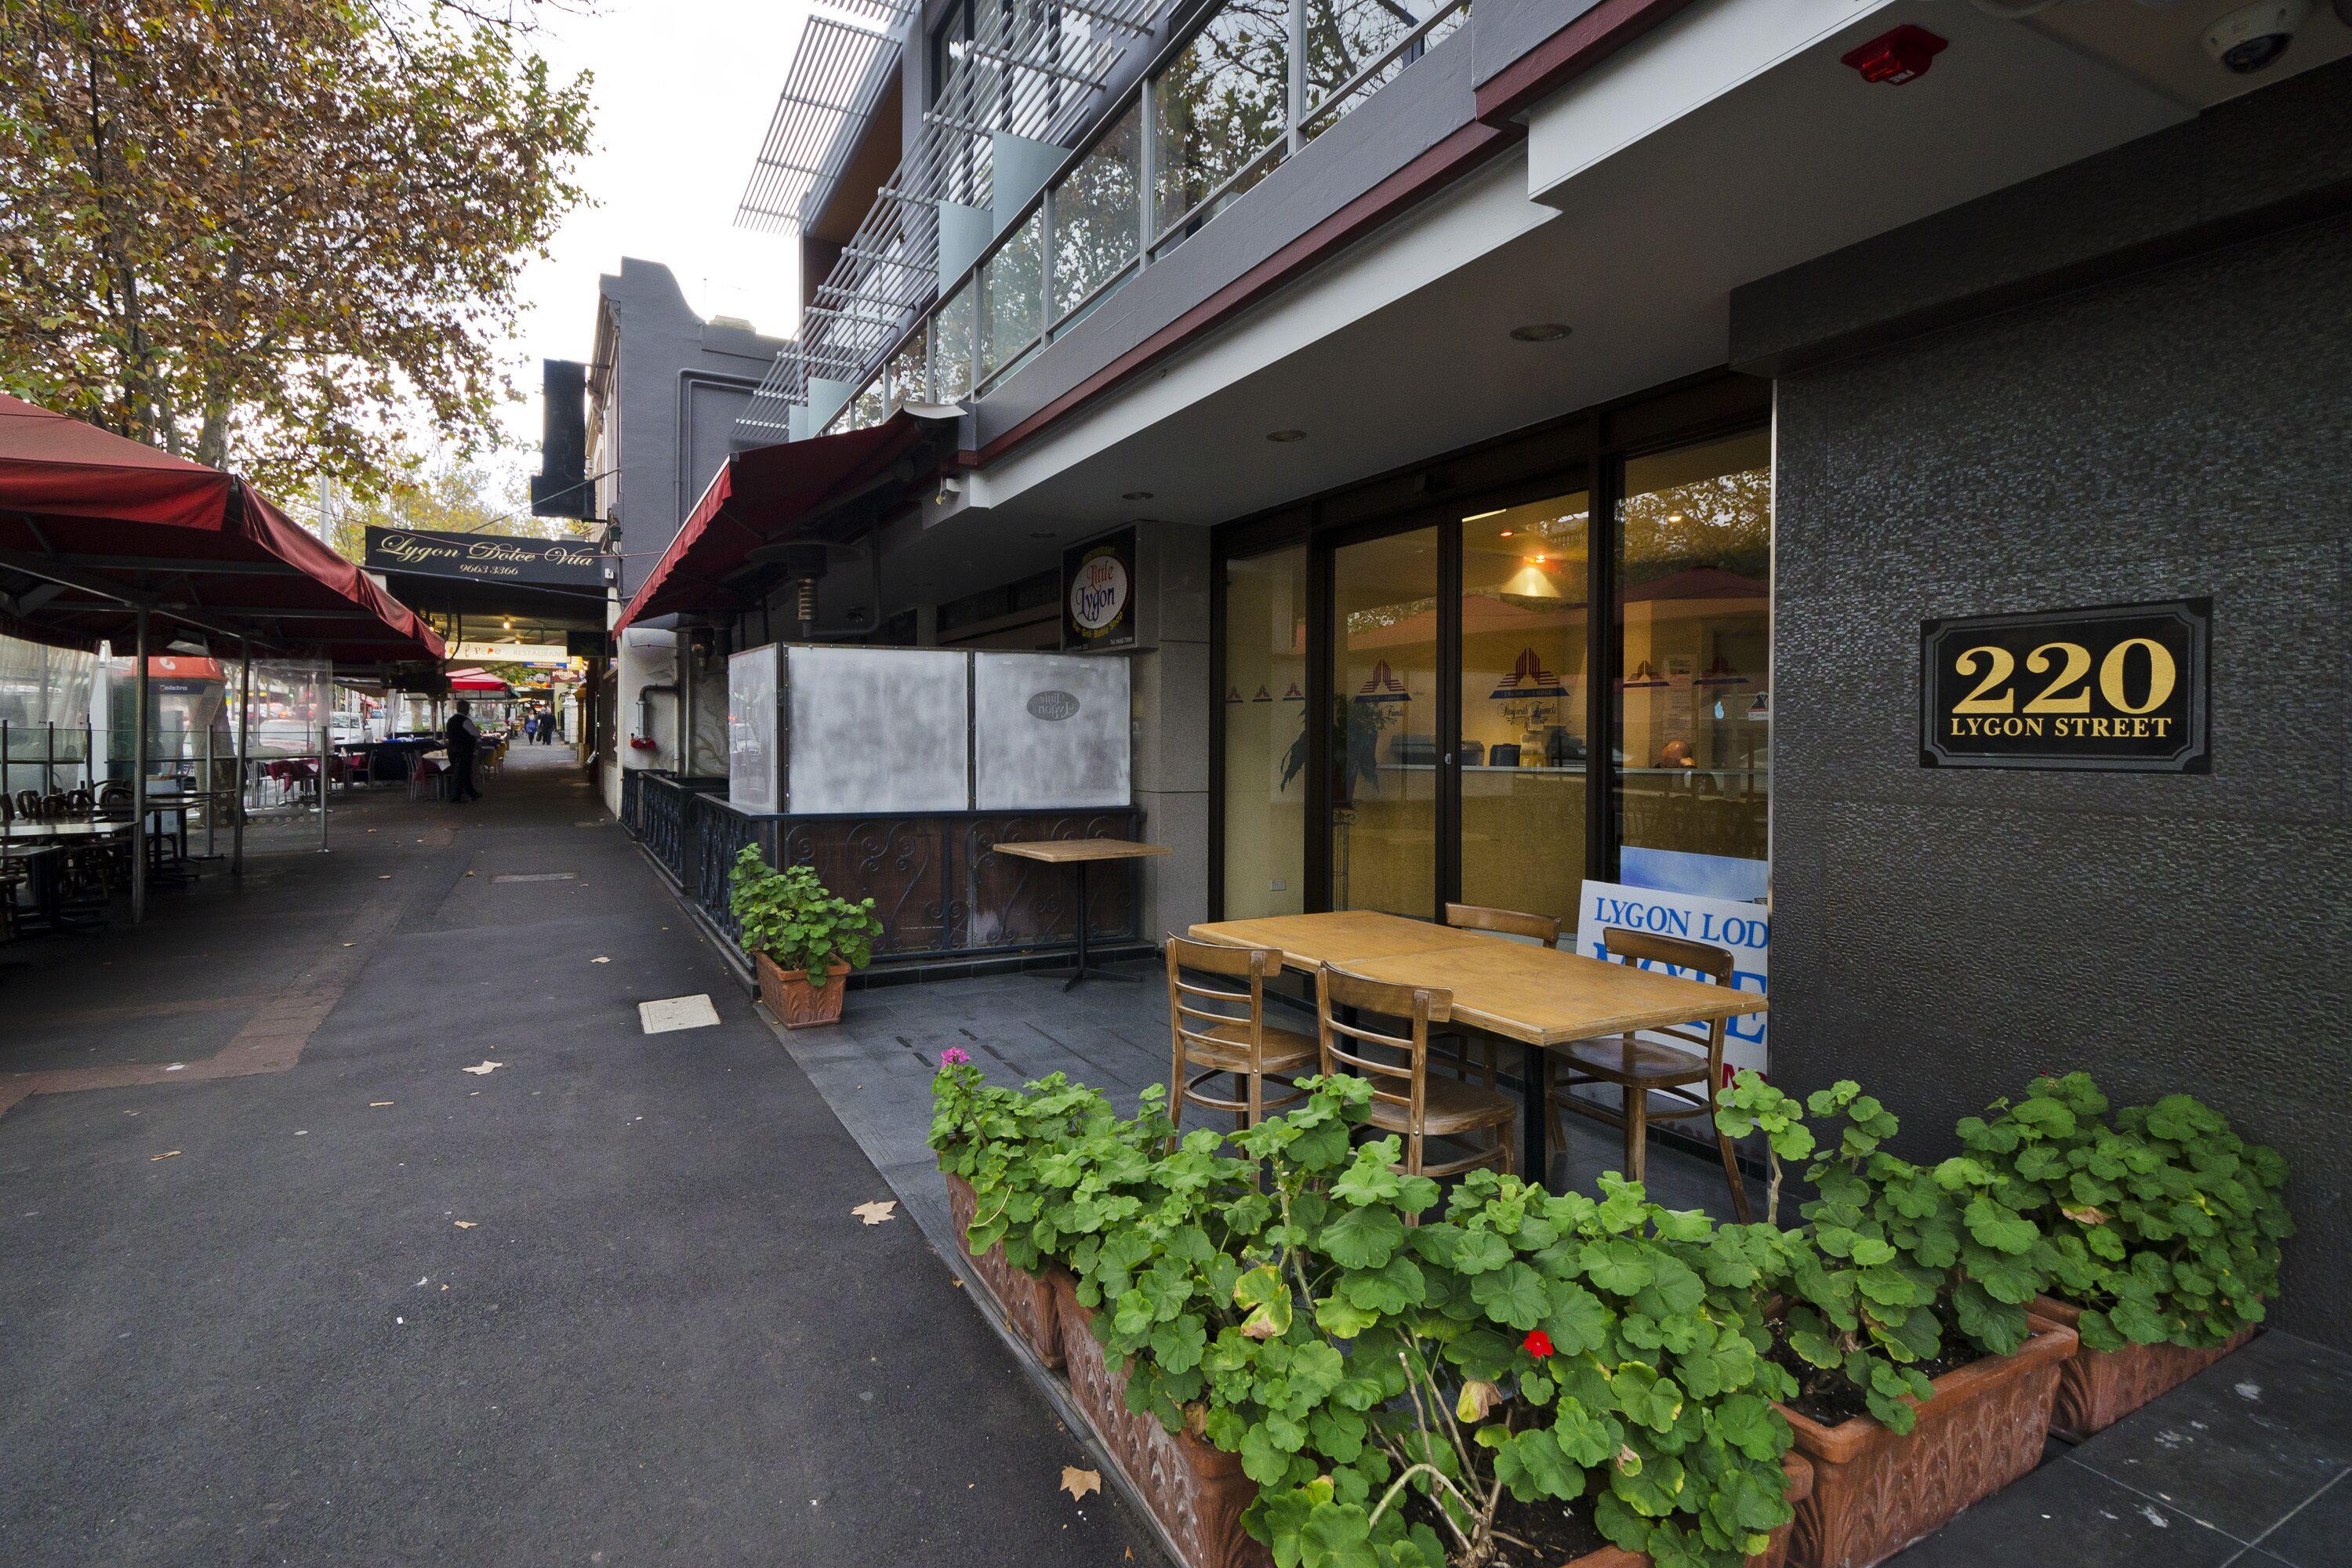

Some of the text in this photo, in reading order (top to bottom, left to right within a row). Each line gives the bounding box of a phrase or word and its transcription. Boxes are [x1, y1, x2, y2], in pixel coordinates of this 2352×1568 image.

[1889, 69, 1915, 83] FIRE
[376, 535, 595, 567] Lygon Dolce Vita
[459, 563, 519, 575] 9663 3366
[1087, 560, 1113, 590] Little
[1076, 586, 1115, 622] Lygon
[1109, 611, 1124, 630] Shop
[1952, 637, 2176, 714] 220
[1951, 717, 2172, 737] LYGON STREET
[1595, 897, 1768, 949] LYGON LOD
